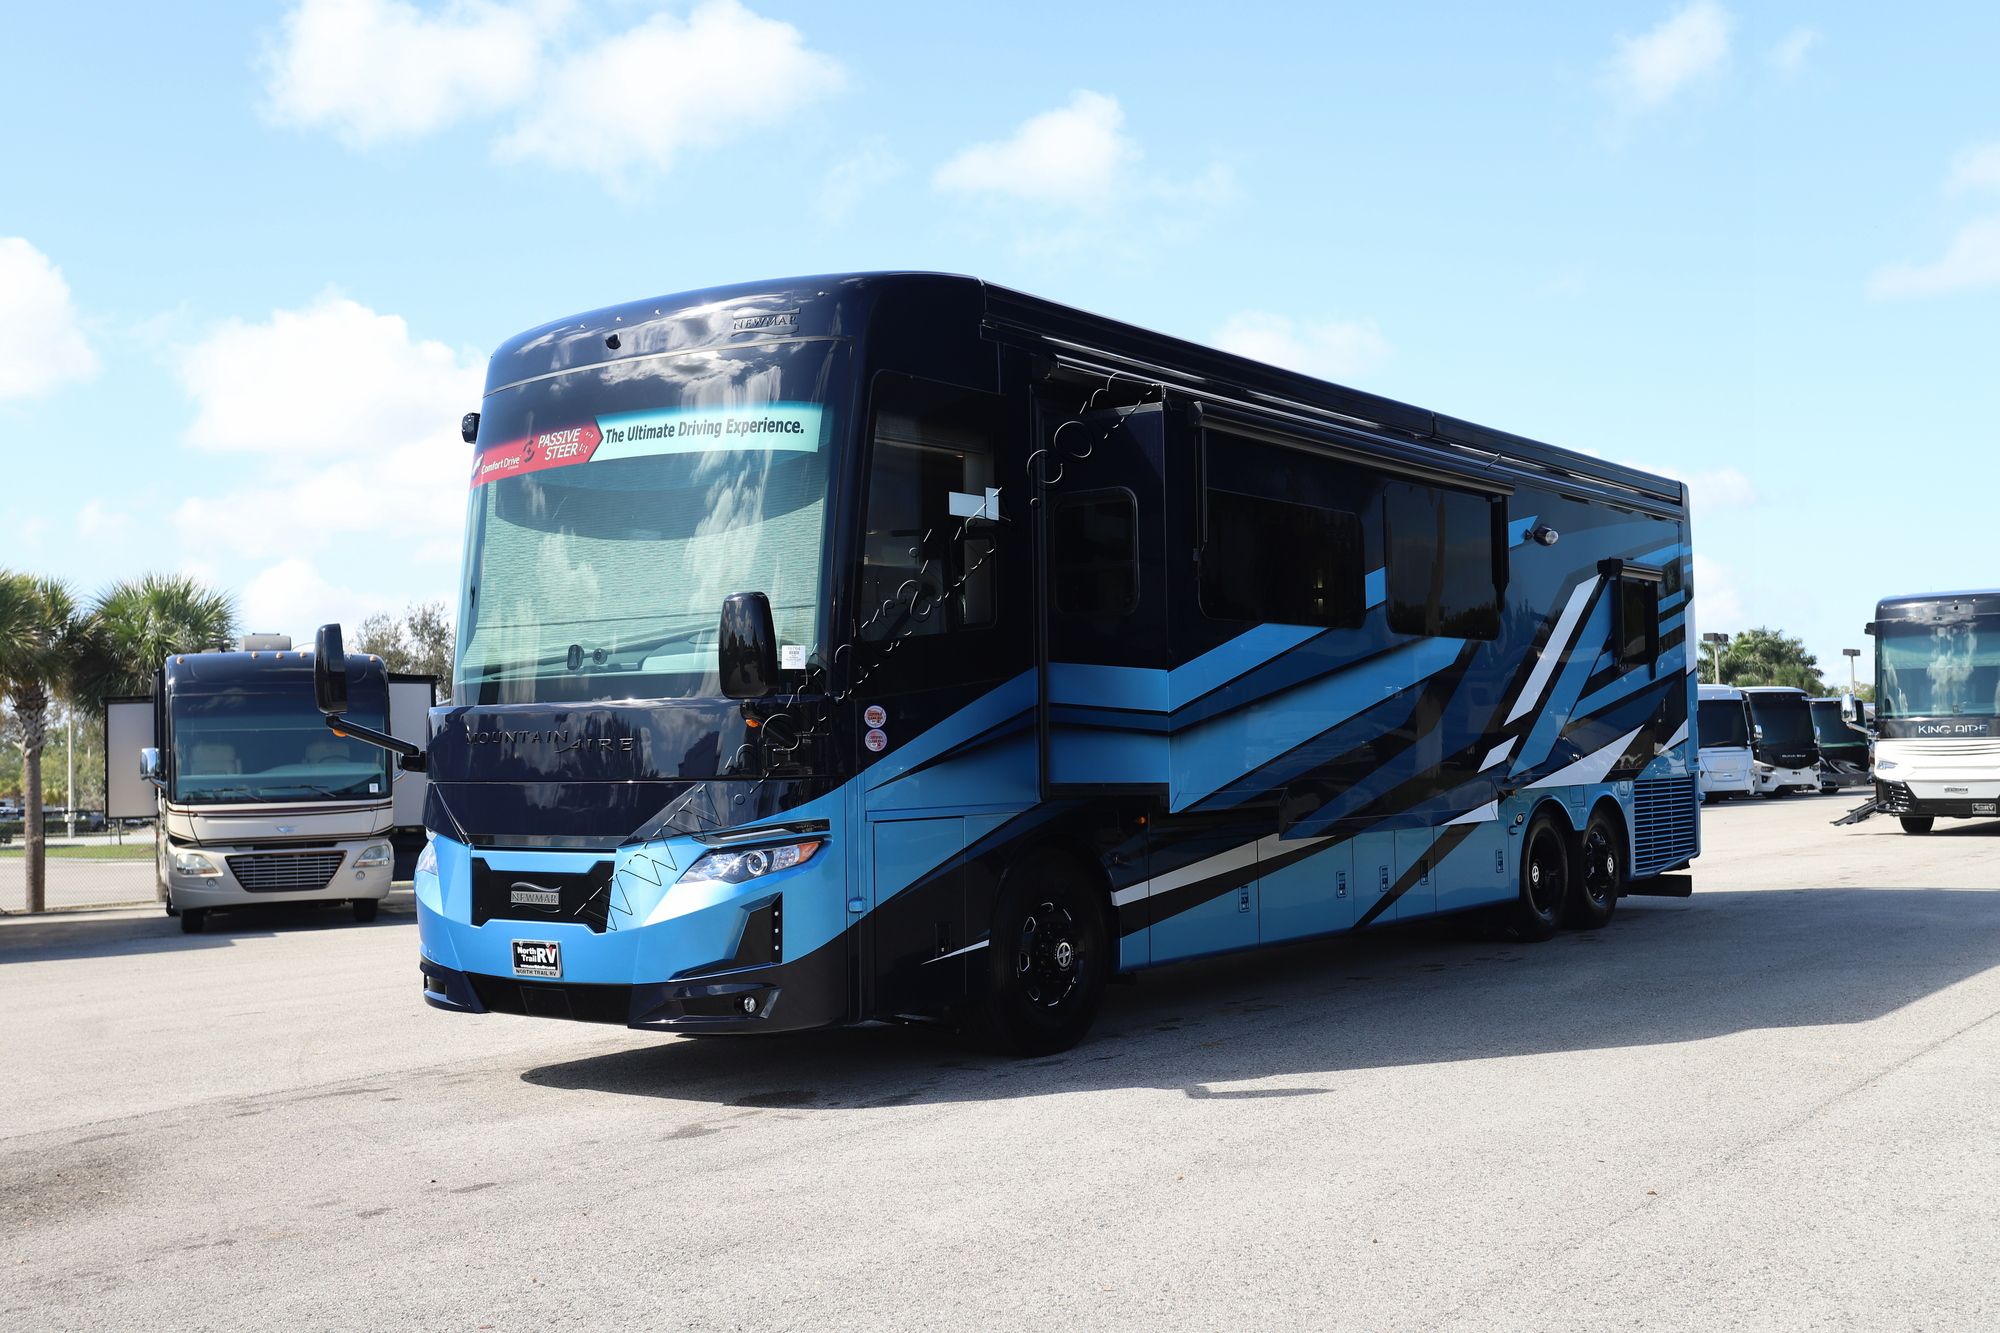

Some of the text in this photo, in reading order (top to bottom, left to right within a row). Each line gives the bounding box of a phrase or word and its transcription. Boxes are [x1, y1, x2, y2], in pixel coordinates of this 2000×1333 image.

[733, 315, 798, 330] NEWMAR
[538, 428, 581, 448] PASSIVE
[606, 417, 805, 443] The Ultimate Driving Experience.
[545, 443, 578, 460] STEER
[481, 456, 520, 475] Comfort Drive
[1918, 725, 1951, 735] KING
[466, 730, 634, 753] MOUNTAIN AIRE
[512, 892, 557, 904] NEWMAR
[517, 946, 556, 963] North RV
[521, 954, 537, 962] Trail
